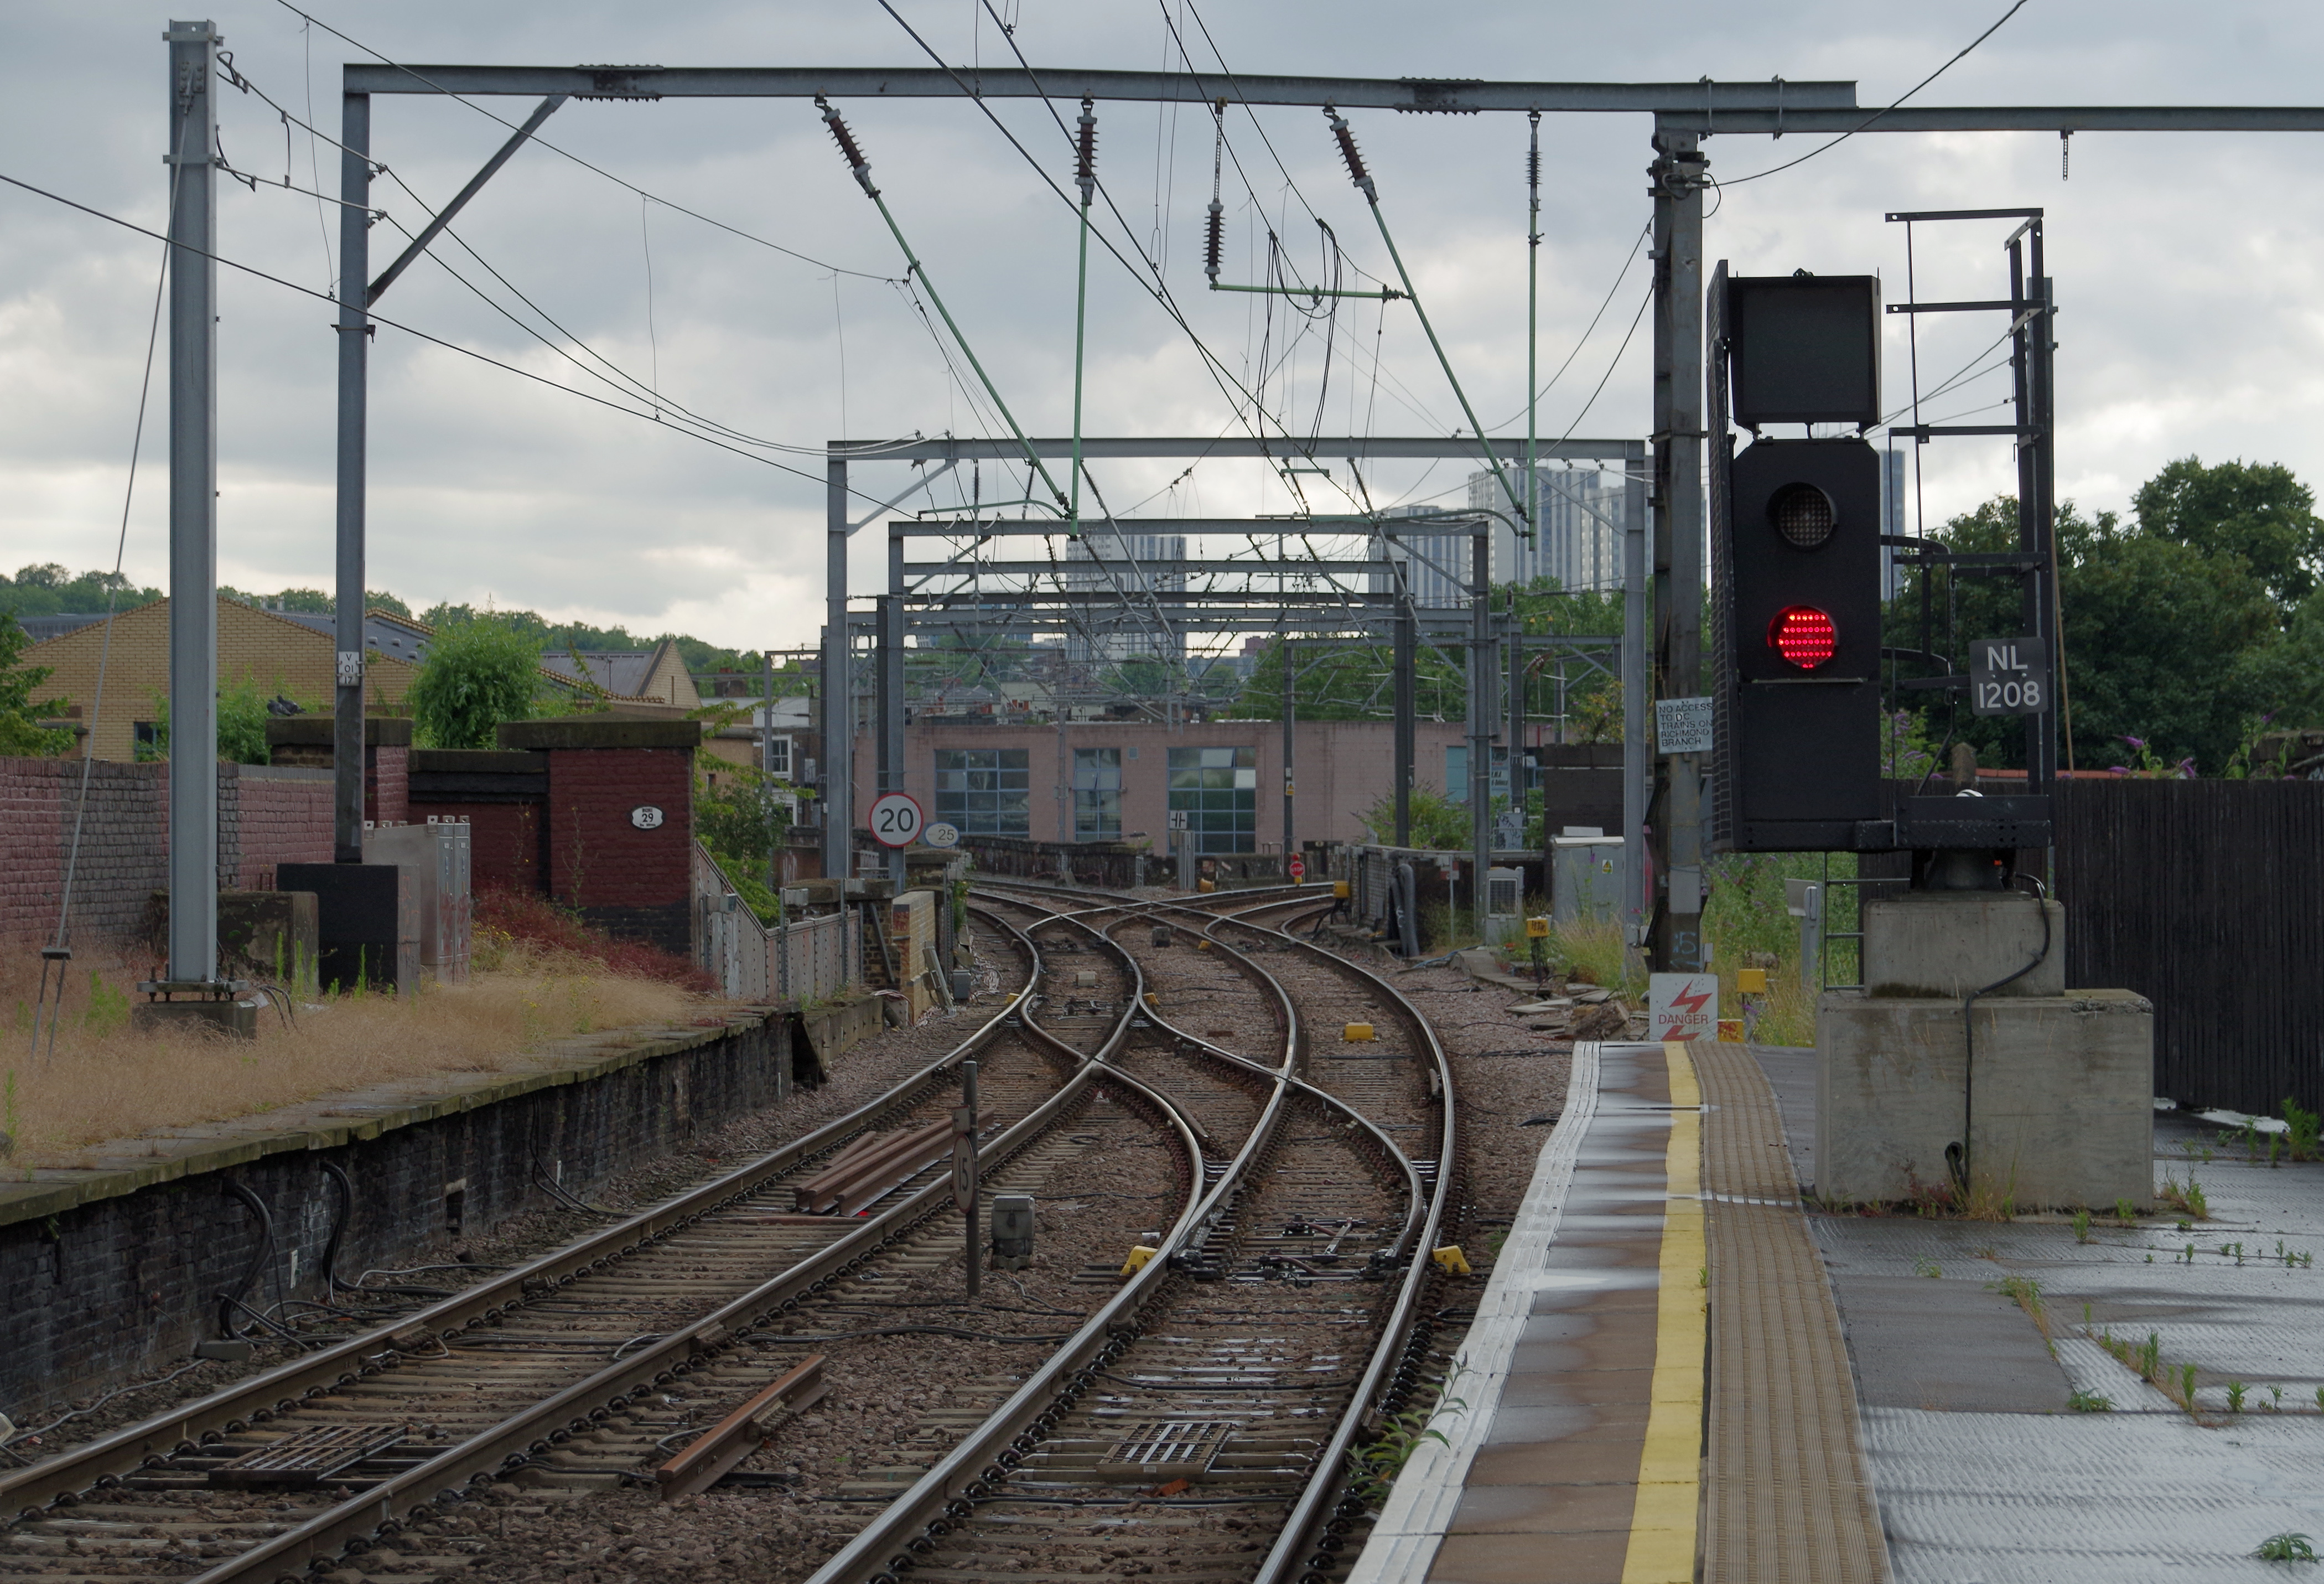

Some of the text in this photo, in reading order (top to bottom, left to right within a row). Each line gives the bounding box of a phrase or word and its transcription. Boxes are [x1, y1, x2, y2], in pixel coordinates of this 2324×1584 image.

[1987, 645, 2028, 671] NL
[1979, 681, 2040, 708] 1208
[1676, 702, 1713, 712] ACCESS
[1661, 721, 1695, 730] TRAINS
[1661, 728, 1709, 738] RICHMOND
[1662, 737, 1701, 747] BRANCH
[642, 813, 653, 822] 29
[880, 807, 914, 832] 20
[938, 829, 954, 841] 25
[1659, 1013, 1708, 1024] DANGER
[958, 1157, 968, 1192] 15
